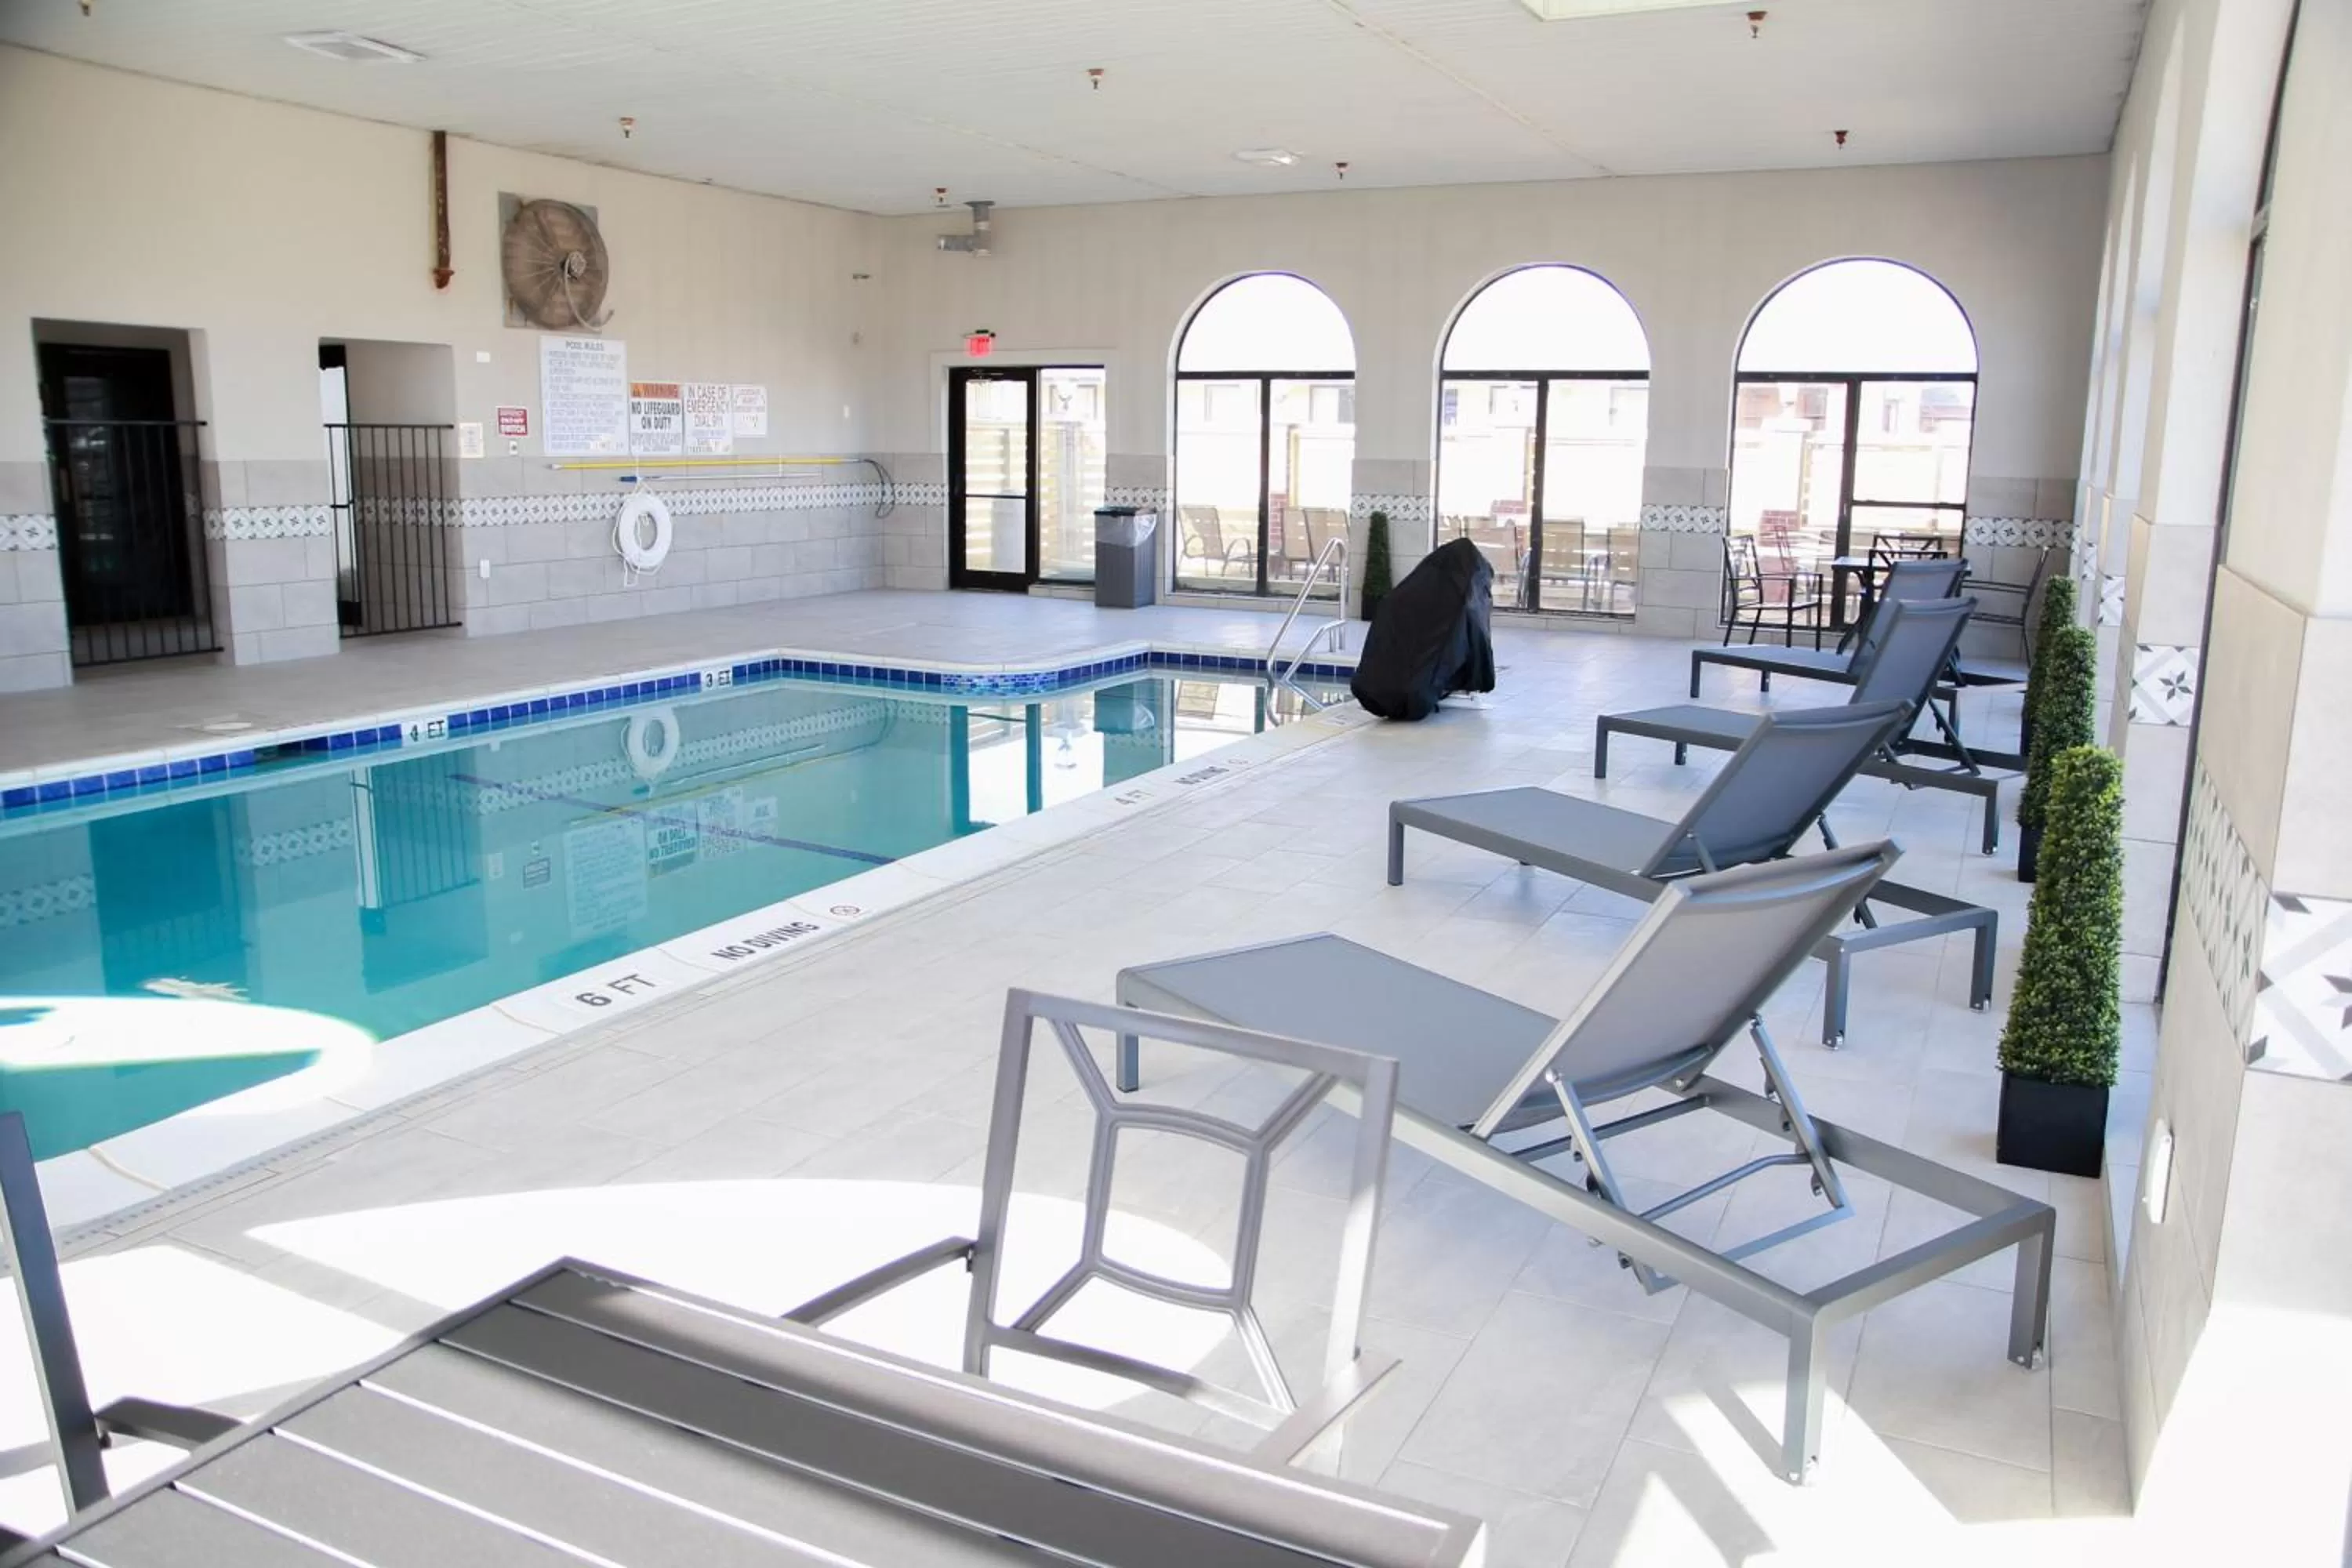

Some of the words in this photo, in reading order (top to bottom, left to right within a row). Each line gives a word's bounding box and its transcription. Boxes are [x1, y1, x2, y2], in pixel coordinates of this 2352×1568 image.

[643, 383, 678, 397] WARNING
[689, 387, 696, 398] IN
[698, 386, 715, 398] CASE
[718, 387, 726, 399] OF
[631, 401, 641, 414] NO
[644, 401, 681, 416] LIFEGUARD
[687, 399, 729, 414] EMERGENCY
[641, 417, 652, 430] ON
[654, 417, 671, 430] DUTY
[694, 415, 711, 426] DIAL
[710, 946, 756, 960] NO
[742, 922, 820, 948] DIVING
[575, 993, 612, 1007] 6
[607, 974, 655, 995] FT
